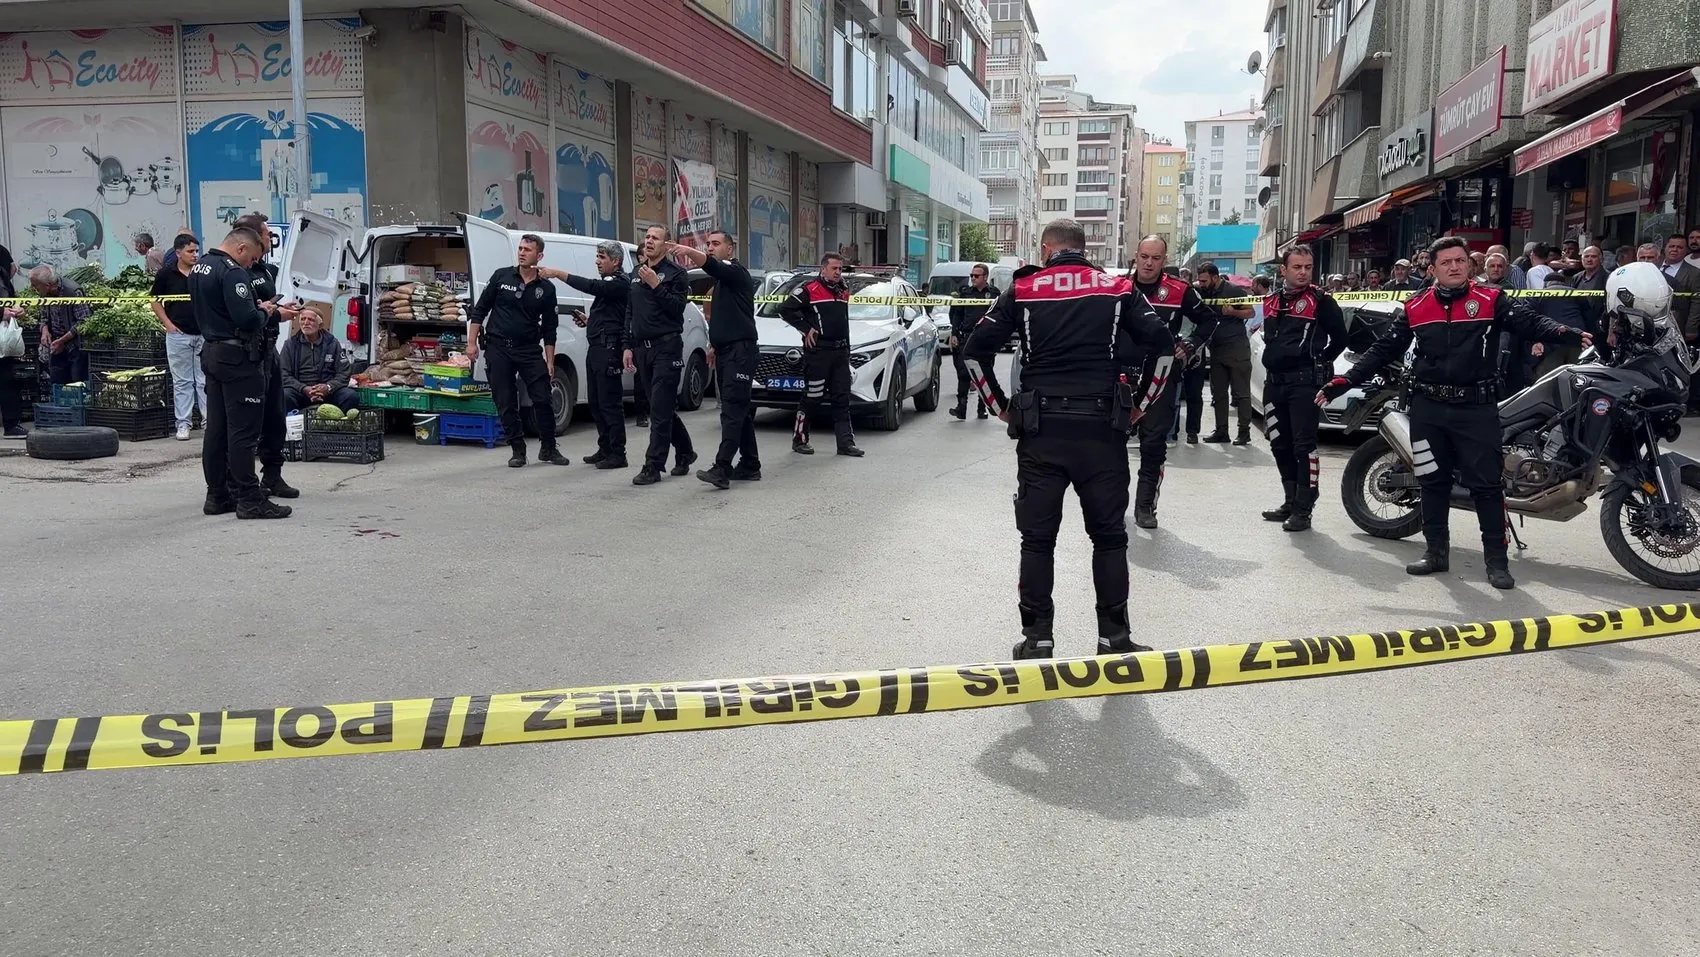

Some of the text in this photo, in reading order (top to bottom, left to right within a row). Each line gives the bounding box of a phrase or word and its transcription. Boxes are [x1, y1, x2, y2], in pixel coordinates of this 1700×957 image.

[76, 50, 160, 92] Ecocity
[261, 43, 344, 85] Eccity
[1527, 9, 1607, 103] MARKET
[1439, 72, 1496, 137] ZÜMRÜT ÇAY EVİ
[695, 199, 711, 217] ÖZEL
[767, 379, 806, 388] 25 A 48
[140, 703, 394, 758] POLİS
[522, 675, 861, 733] GİRİLMEZ
[960, 654, 1146, 697] POLİS
[1238, 621, 1499, 673] GİRİLMEZ
